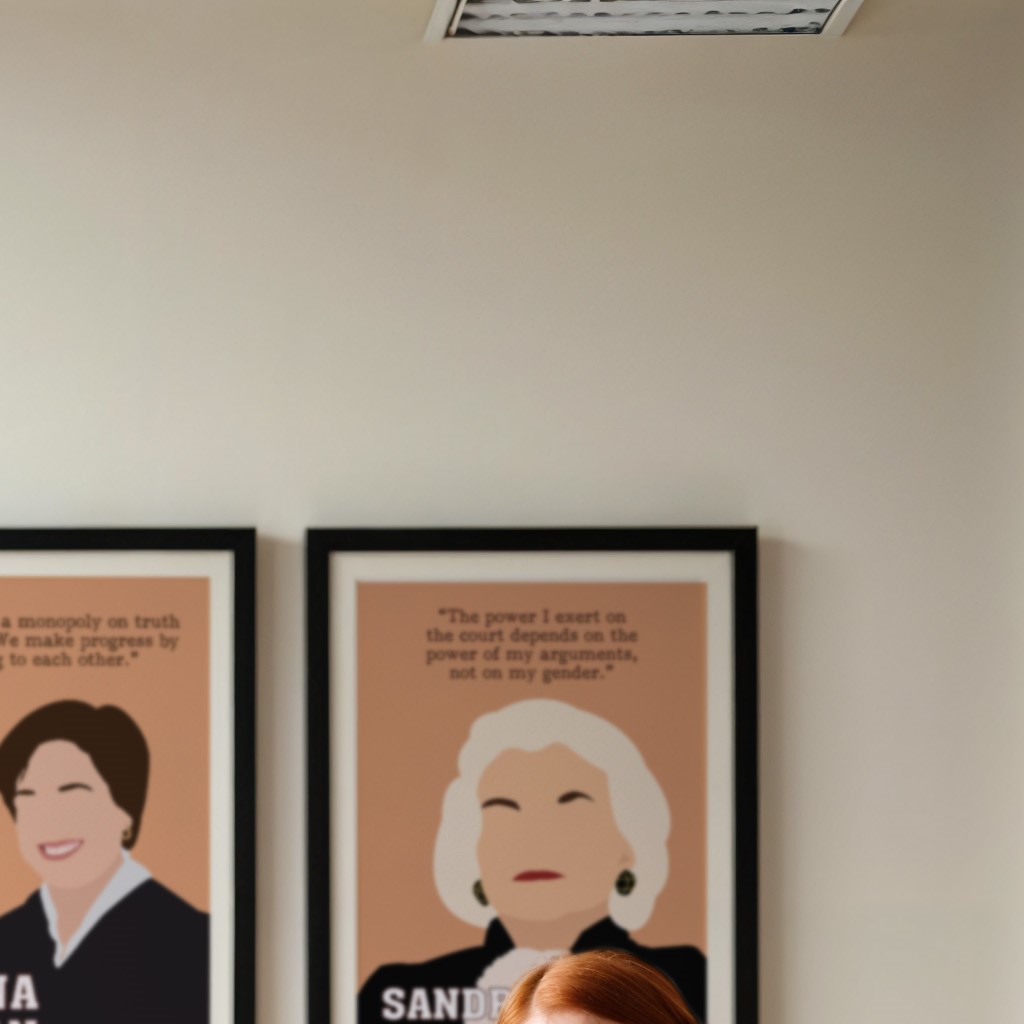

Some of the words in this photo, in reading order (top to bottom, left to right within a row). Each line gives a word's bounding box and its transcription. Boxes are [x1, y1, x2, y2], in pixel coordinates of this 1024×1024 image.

[0, 615, 12, 629] a
[17, 613, 103, 633] monopoly
[107, 615, 129, 629] on
[134, 613, 181, 629] truth
[437, 607, 480, 624] "The
[484, 611, 537, 628] power
[542, 608, 551, 624] I
[554, 609, 600, 624] exert
[605, 611, 627, 624] on
[24, 632, 74, 647] make
[80, 634, 154, 651] progress
[158, 632, 181, 651] by
[425, 627, 455, 642] the
[459, 629, 504, 642] court
[510, 627, 578, 646] depends
[584, 630, 604, 642] on
[610, 627, 638, 642] the
[9, 652, 28, 667] to
[31, 651, 73, 667] each
[77, 650, 139, 667] other."
[425, 648, 477, 666] power
[483, 646, 501, 662] of
[506, 649, 533, 665] my
[539, 648, 638, 666] arguments,
[449, 667, 477, 680] not
[482, 668, 503, 680] on
[508, 668, 537, 684] my
[542, 664, 614, 684] gender."
